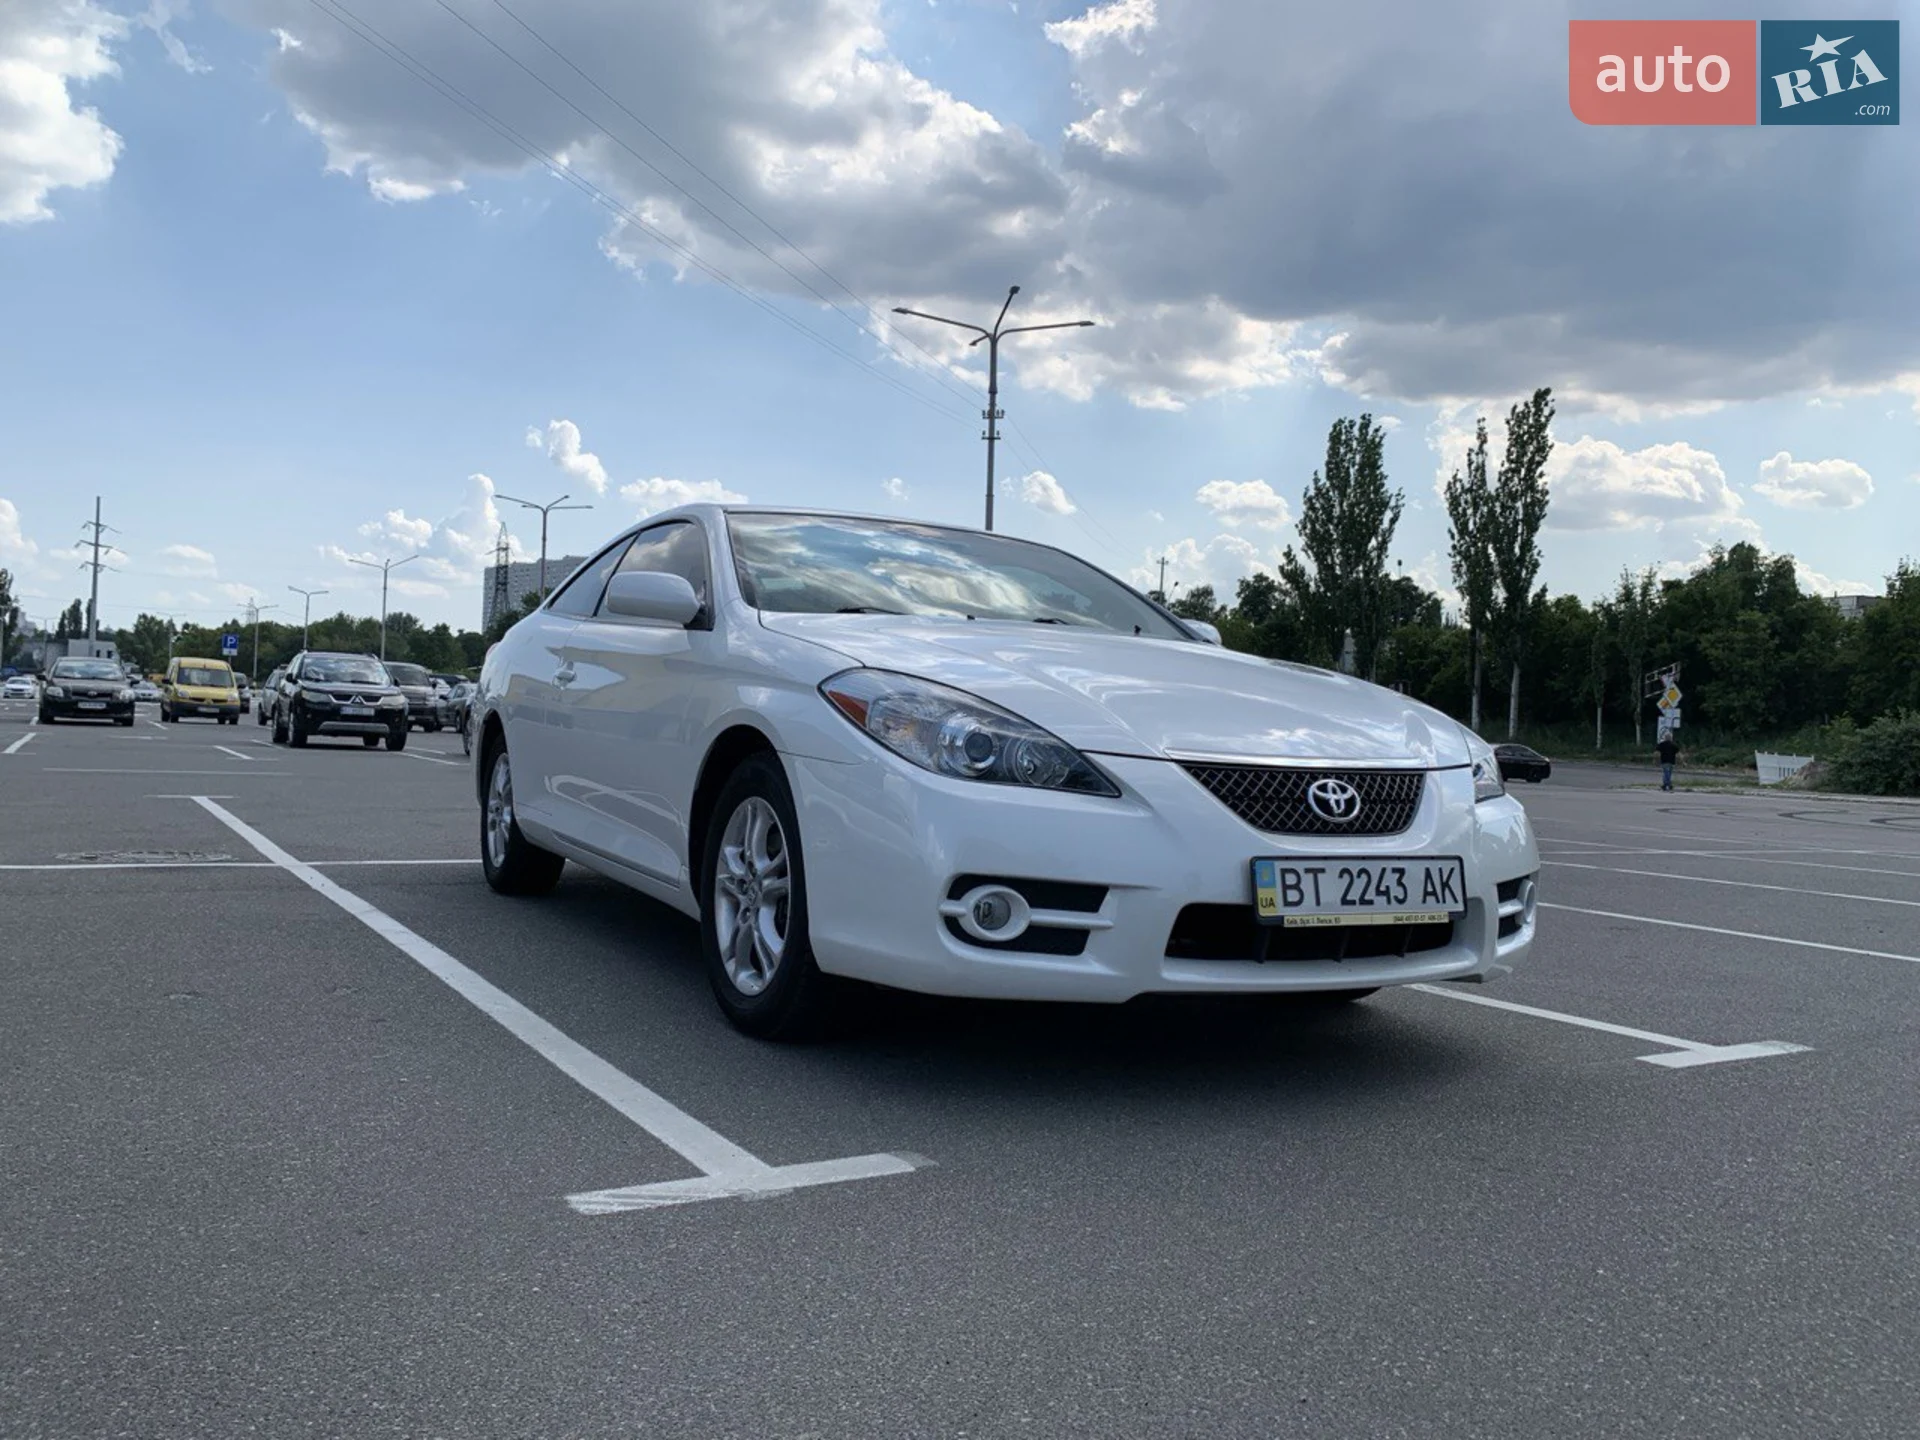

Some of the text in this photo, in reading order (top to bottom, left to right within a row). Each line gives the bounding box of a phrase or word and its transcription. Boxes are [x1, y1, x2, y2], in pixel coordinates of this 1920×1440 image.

[227, 636, 236, 647] P
[1280, 866, 1459, 907] BT 2243 AK
[1260, 897, 1276, 908] UA
